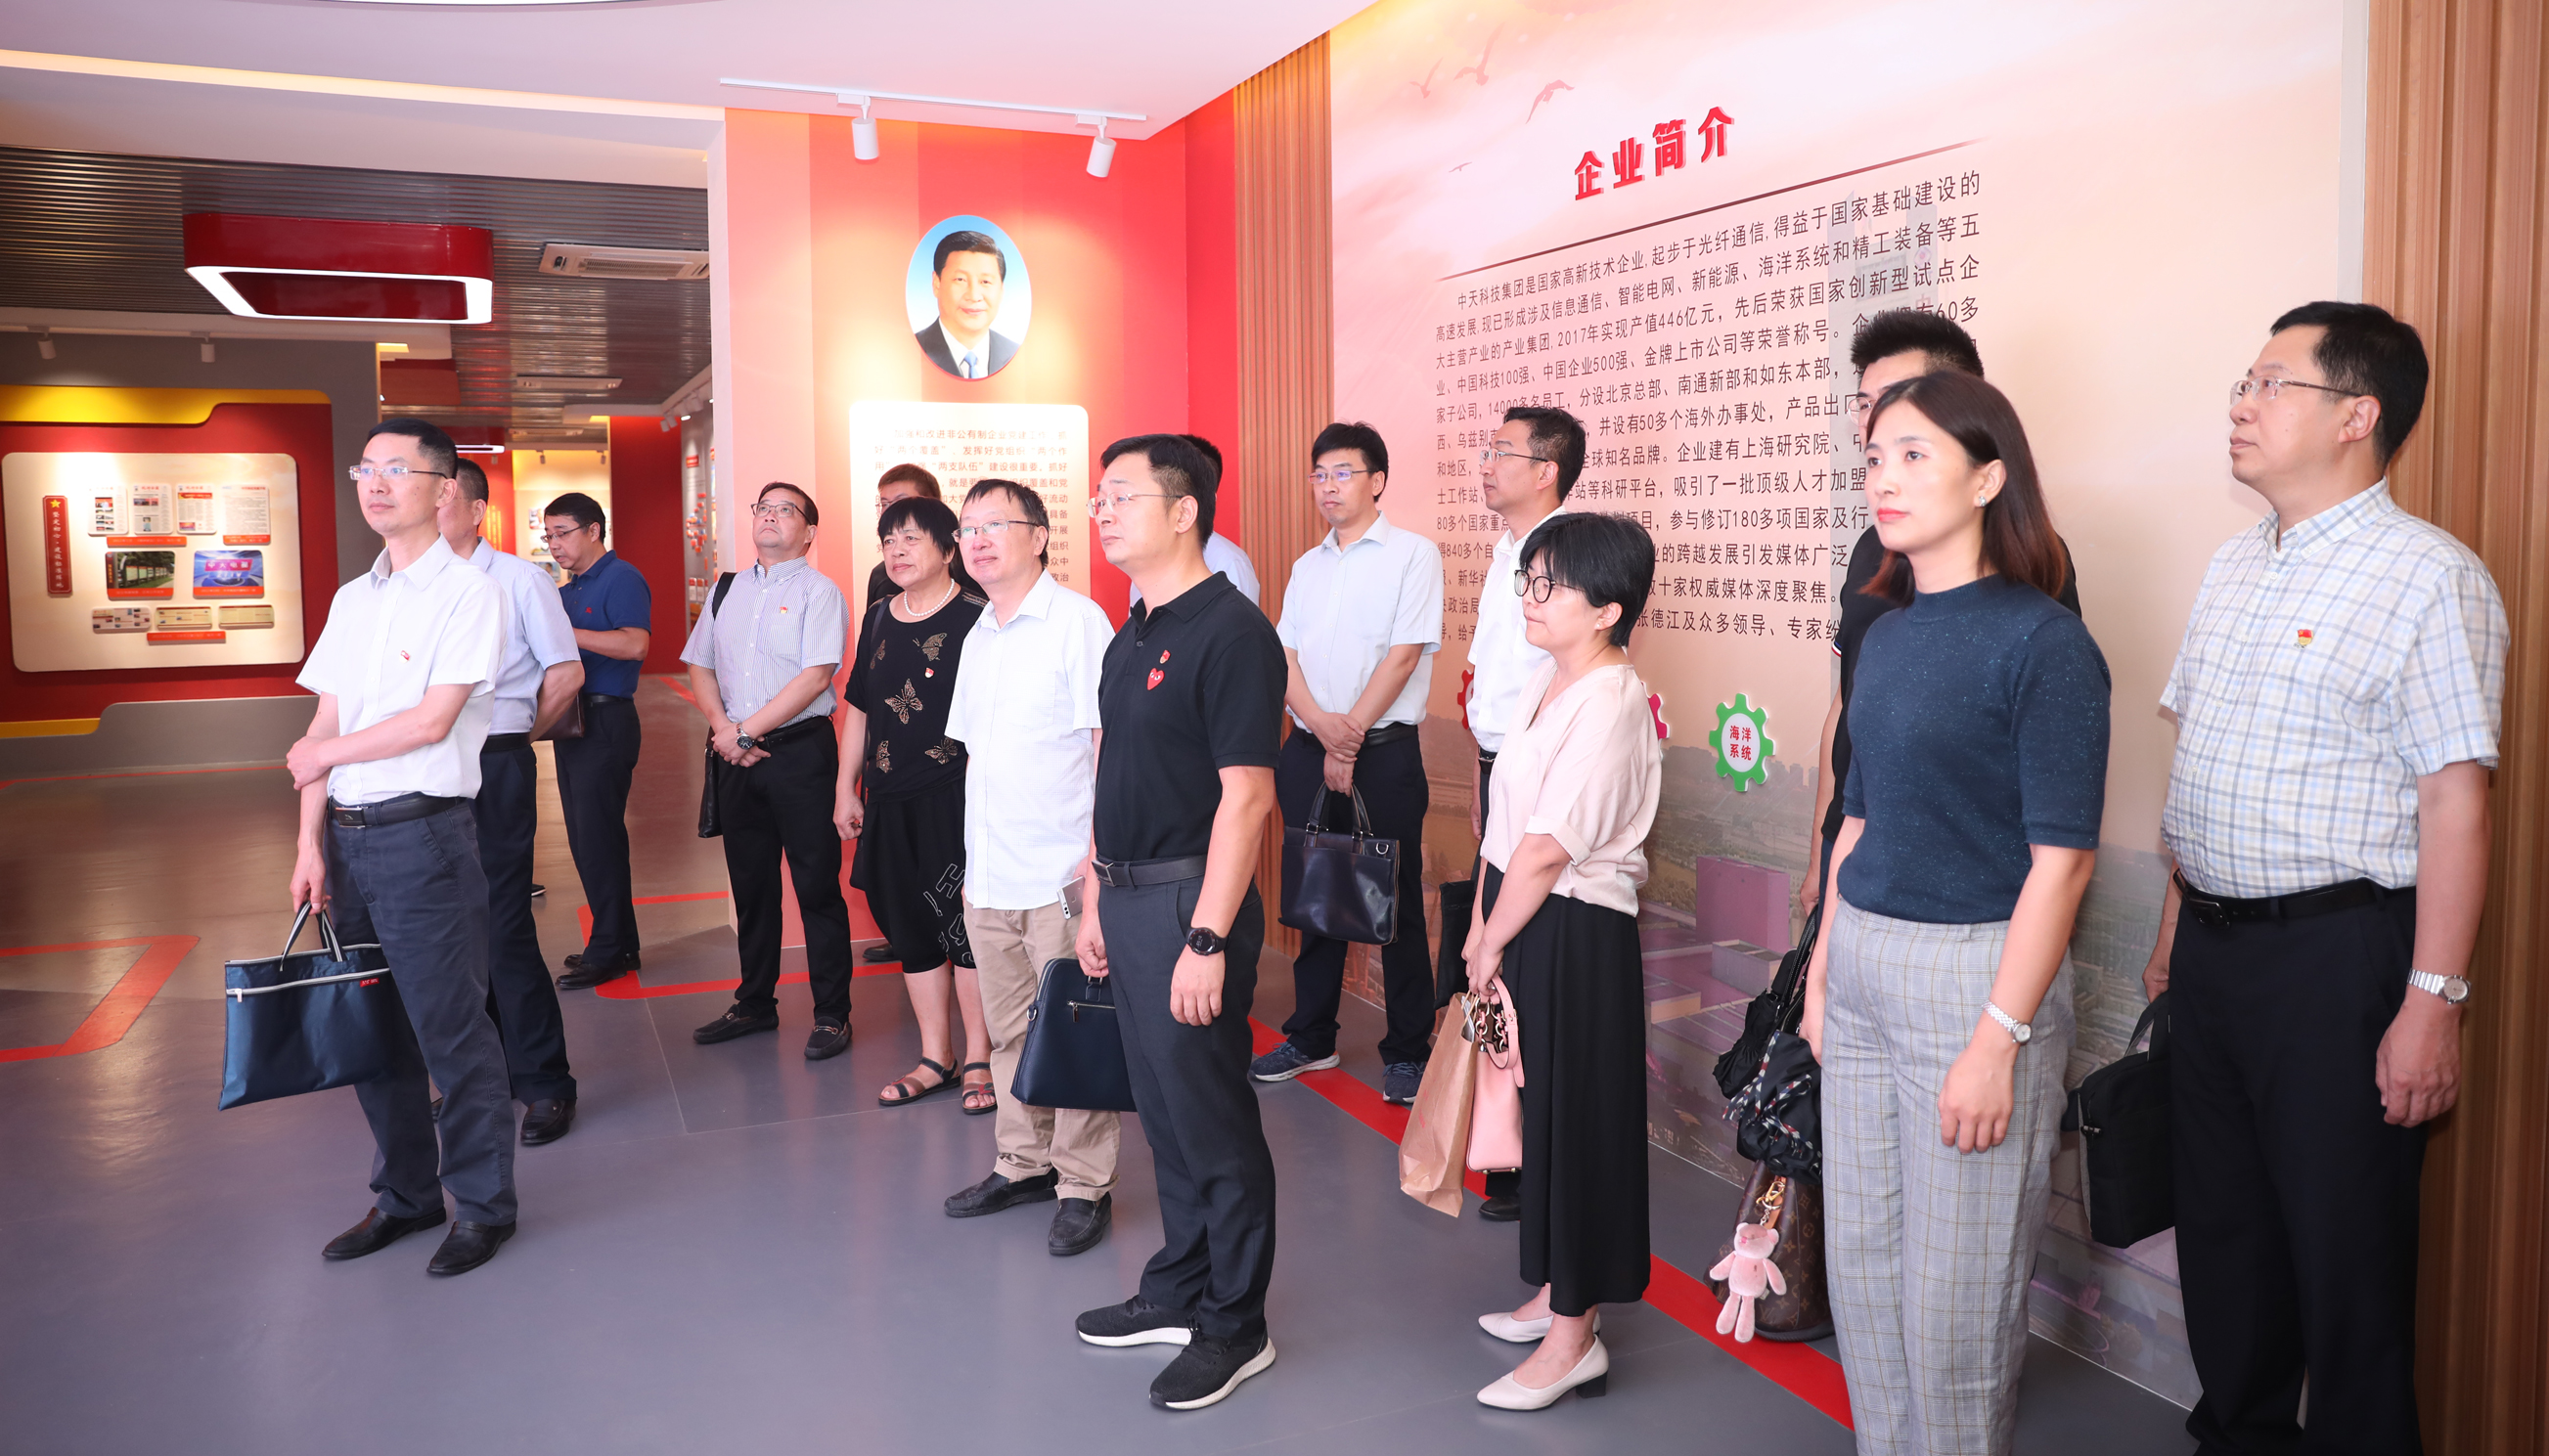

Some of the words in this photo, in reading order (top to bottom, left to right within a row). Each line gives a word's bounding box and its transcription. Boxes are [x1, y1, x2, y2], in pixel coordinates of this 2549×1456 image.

[1575, 106, 1734, 200] 企业简介
[1436, 356, 1859, 424] 家子公司，14000多名员工，分设北京总部、南通新部和如东本部，
[1729, 725, 1752, 742] 海洋
[1729, 743, 1752, 761] 系统
